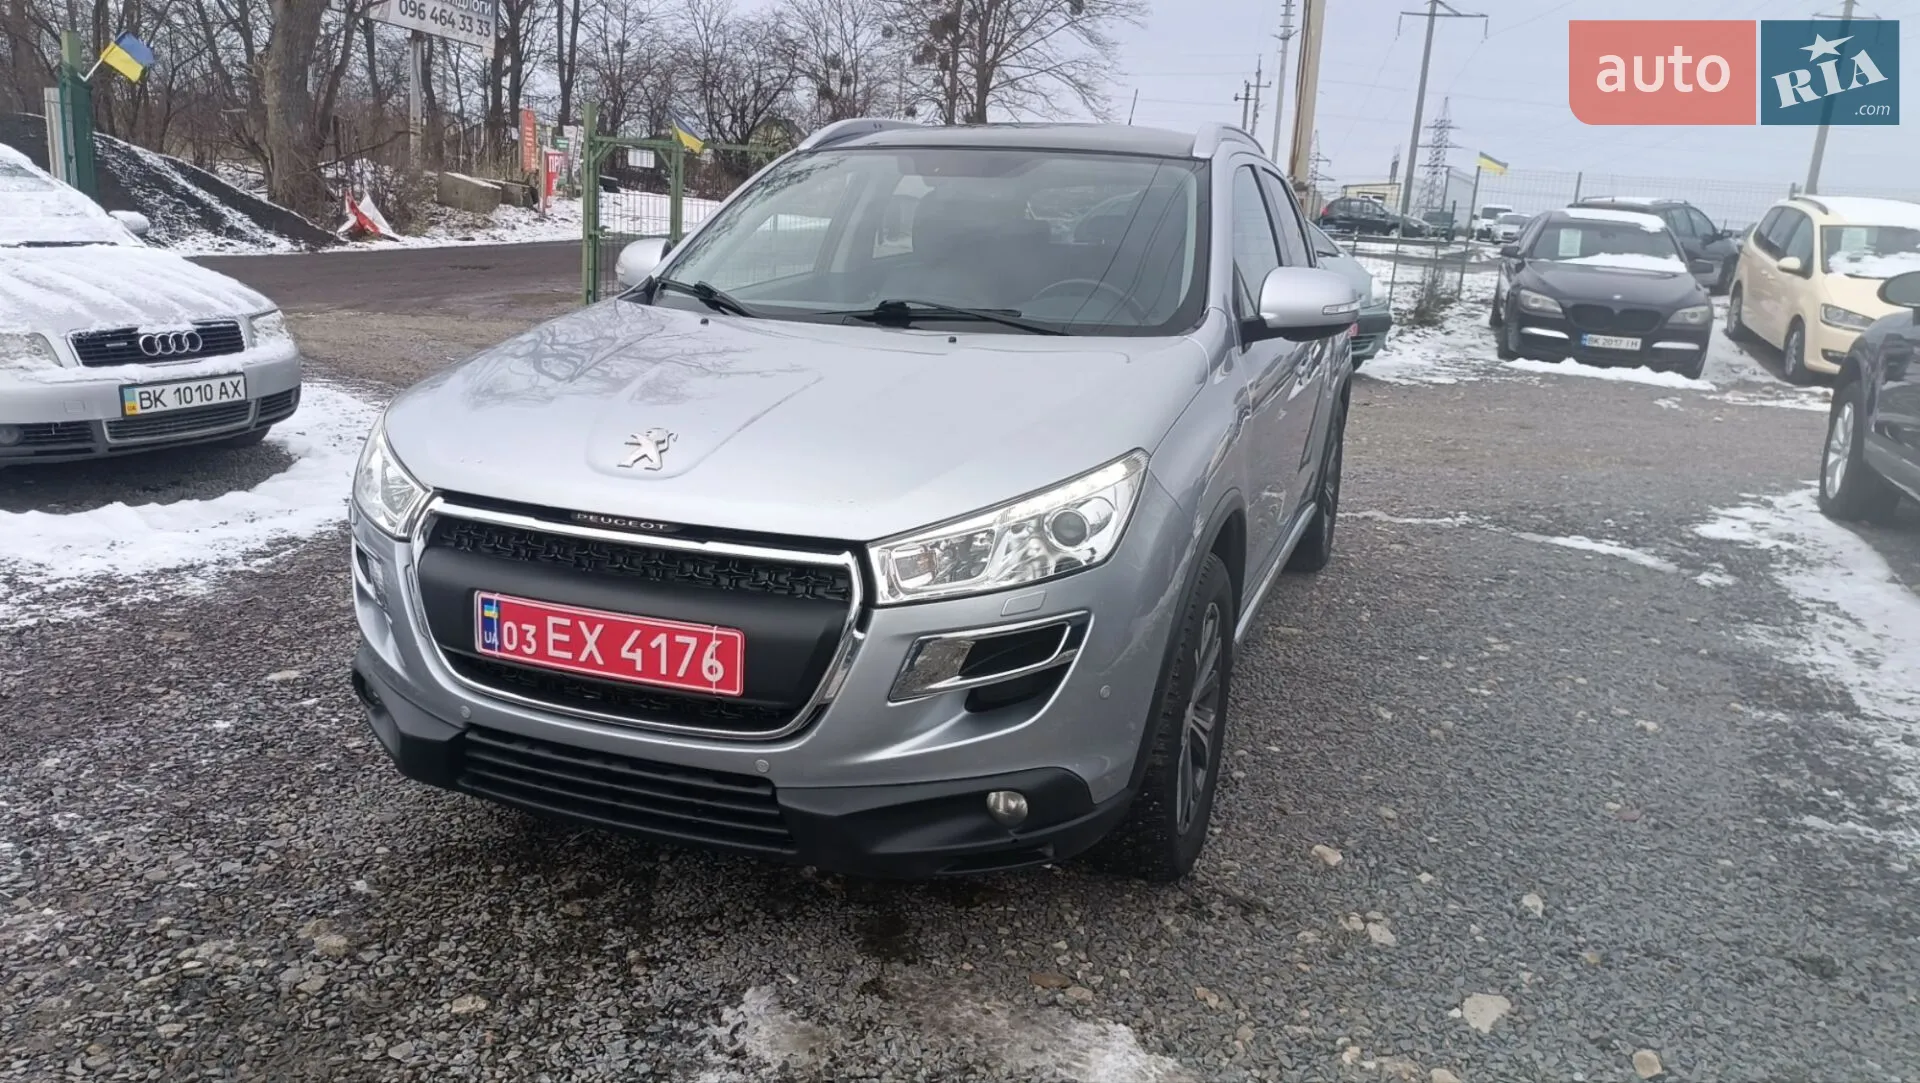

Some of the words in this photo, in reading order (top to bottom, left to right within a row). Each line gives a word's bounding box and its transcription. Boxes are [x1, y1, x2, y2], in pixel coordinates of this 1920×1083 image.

[399, 0, 426, 20] 096
[430, 6, 456, 28] 464
[459, 14, 474, 33] 33
[476, 19, 491, 37] 33
[138, 388, 168, 410] BK
[173, 383, 214, 406] 1010
[219, 379, 242, 400] AX
[577, 512, 668, 530] PEUGEOT
[503, 620, 537, 655] 03
[546, 615, 604, 666] EX
[620, 629, 725, 682] 4176
